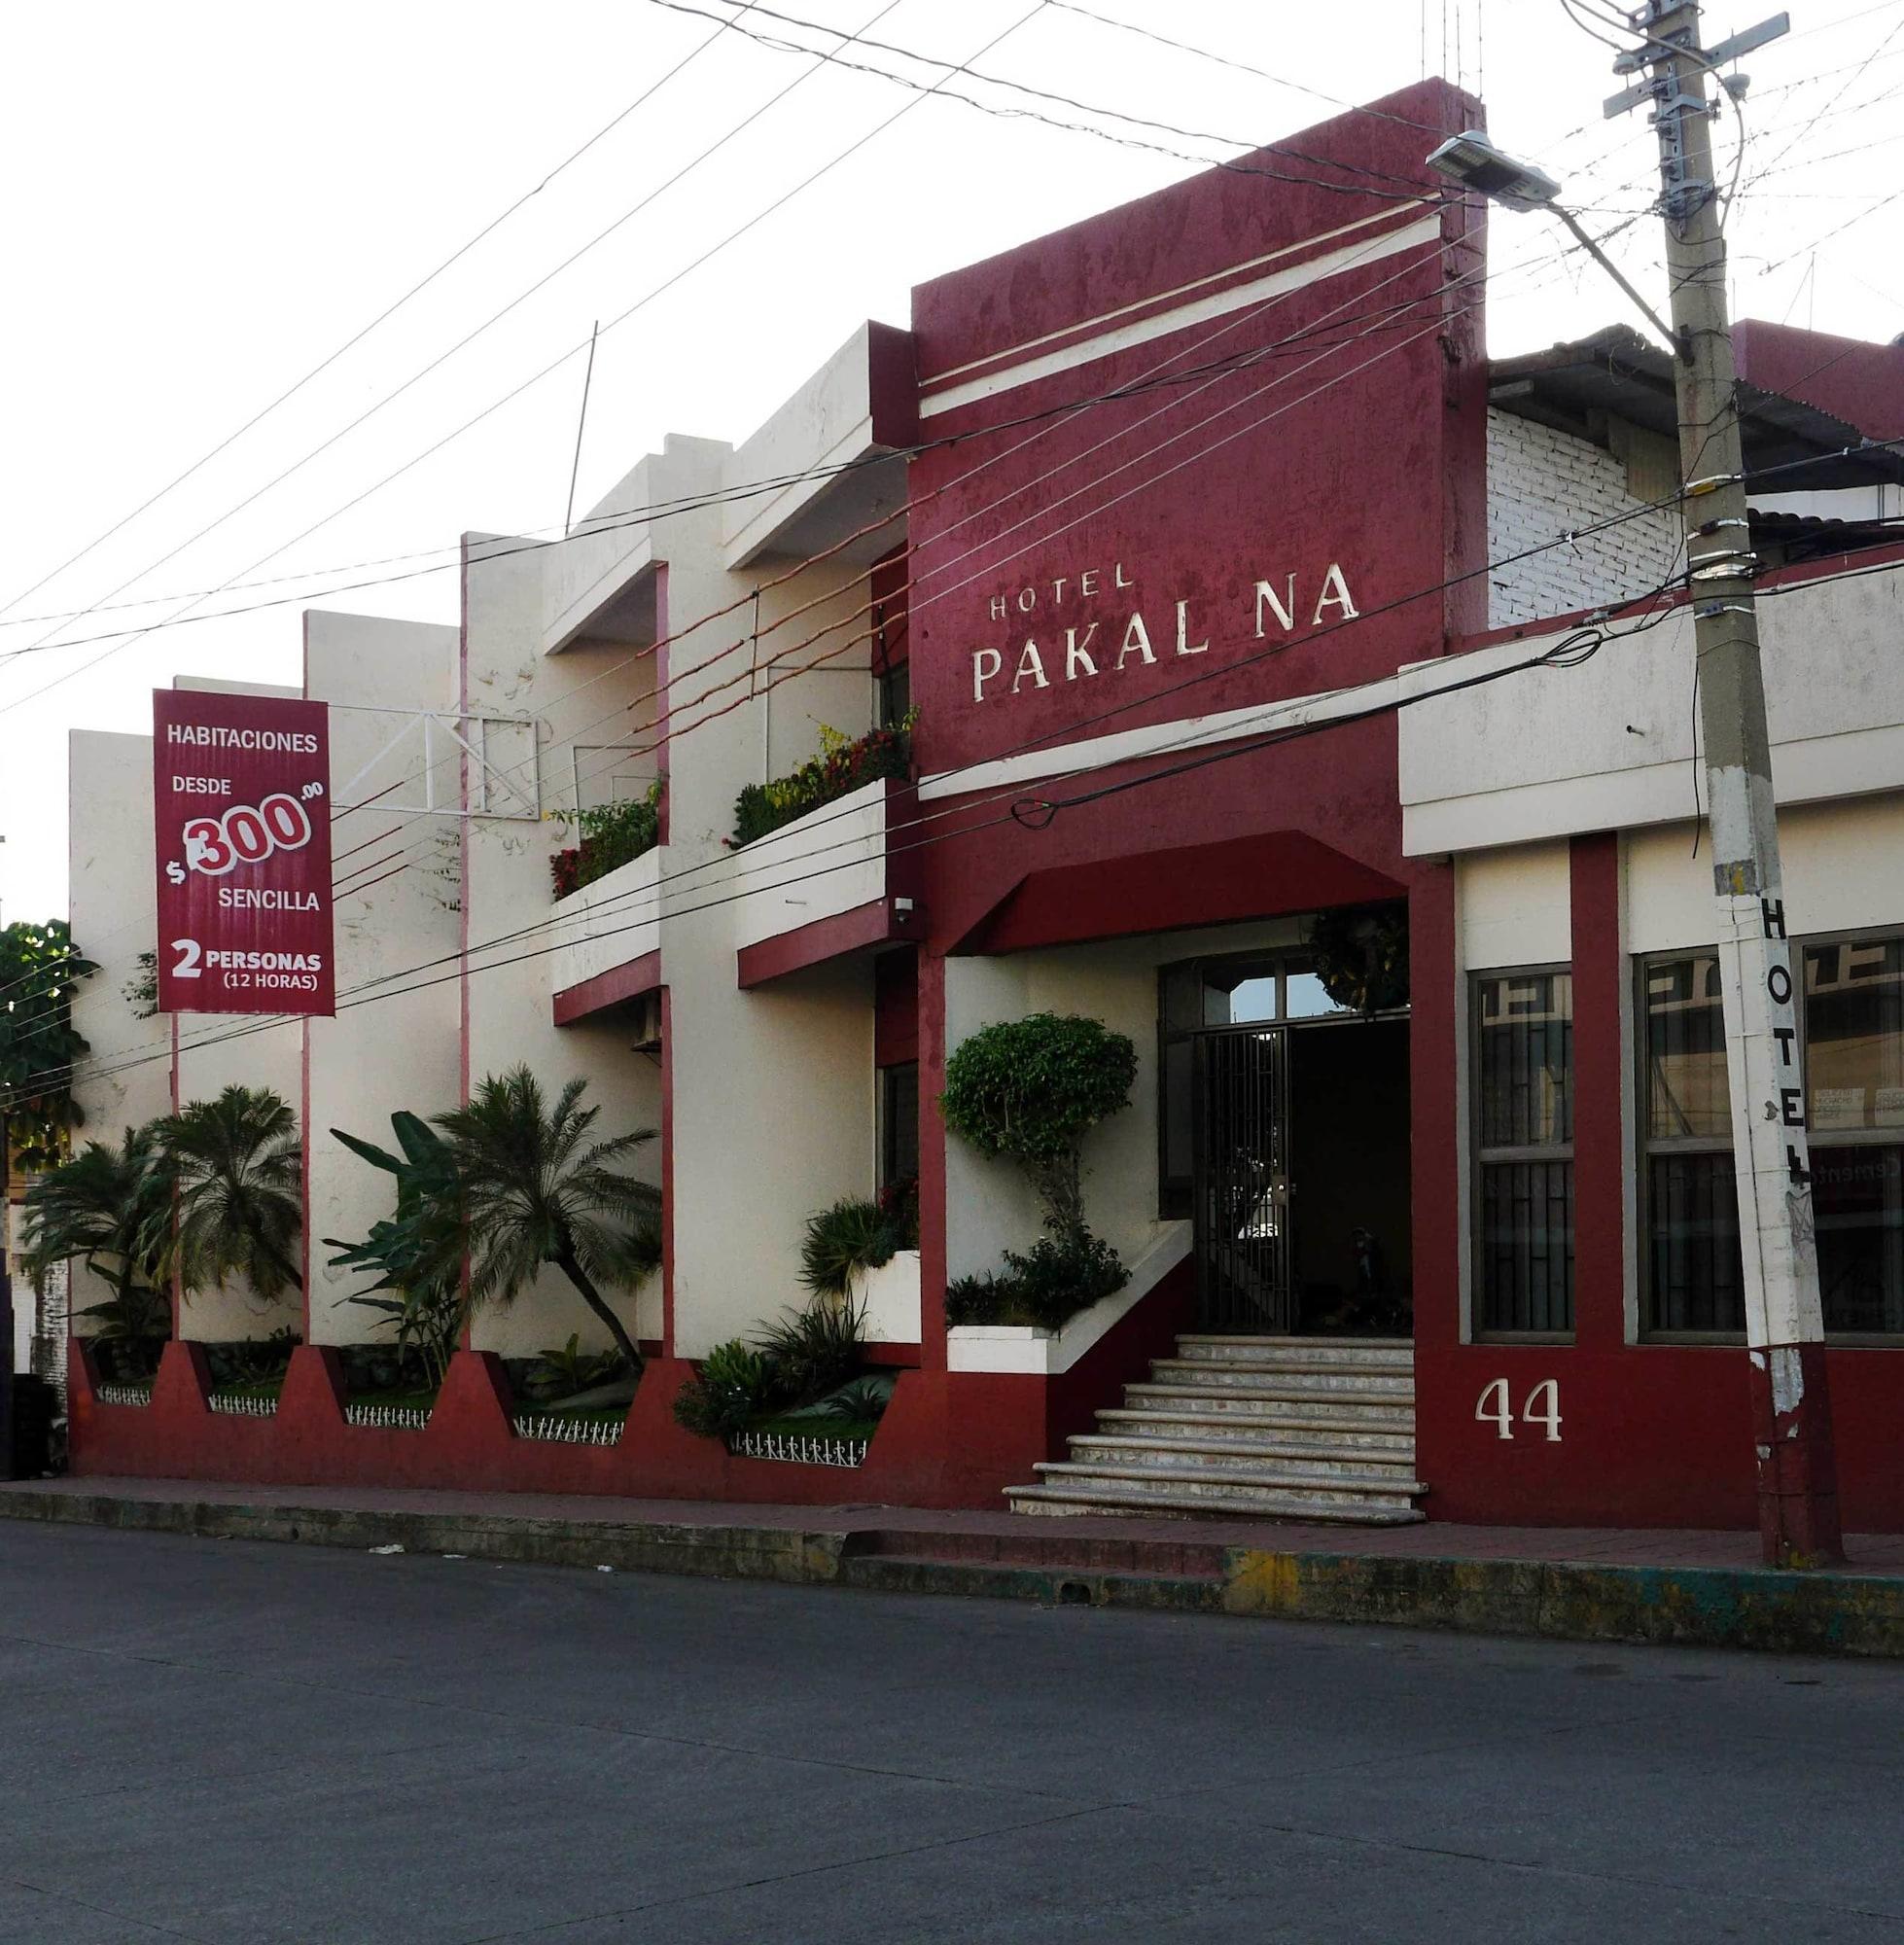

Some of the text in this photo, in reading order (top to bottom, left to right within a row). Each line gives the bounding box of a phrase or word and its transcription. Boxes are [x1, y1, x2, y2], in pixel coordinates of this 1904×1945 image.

[989, 561, 1134, 621] HOTEL
[972, 562, 1360, 704] PAKAL NA
[167, 724, 319, 755] HABITACIONES
[172, 775, 232, 796] DESDE
[218, 887, 321, 911] SENCILLA
[169, 937, 322, 978] 2 PERSONAS
[223, 972, 319, 992] (12 HORAS)
[1760, 898, 1812, 1185] HOTEL
[1474, 1377, 1564, 1442] 44
